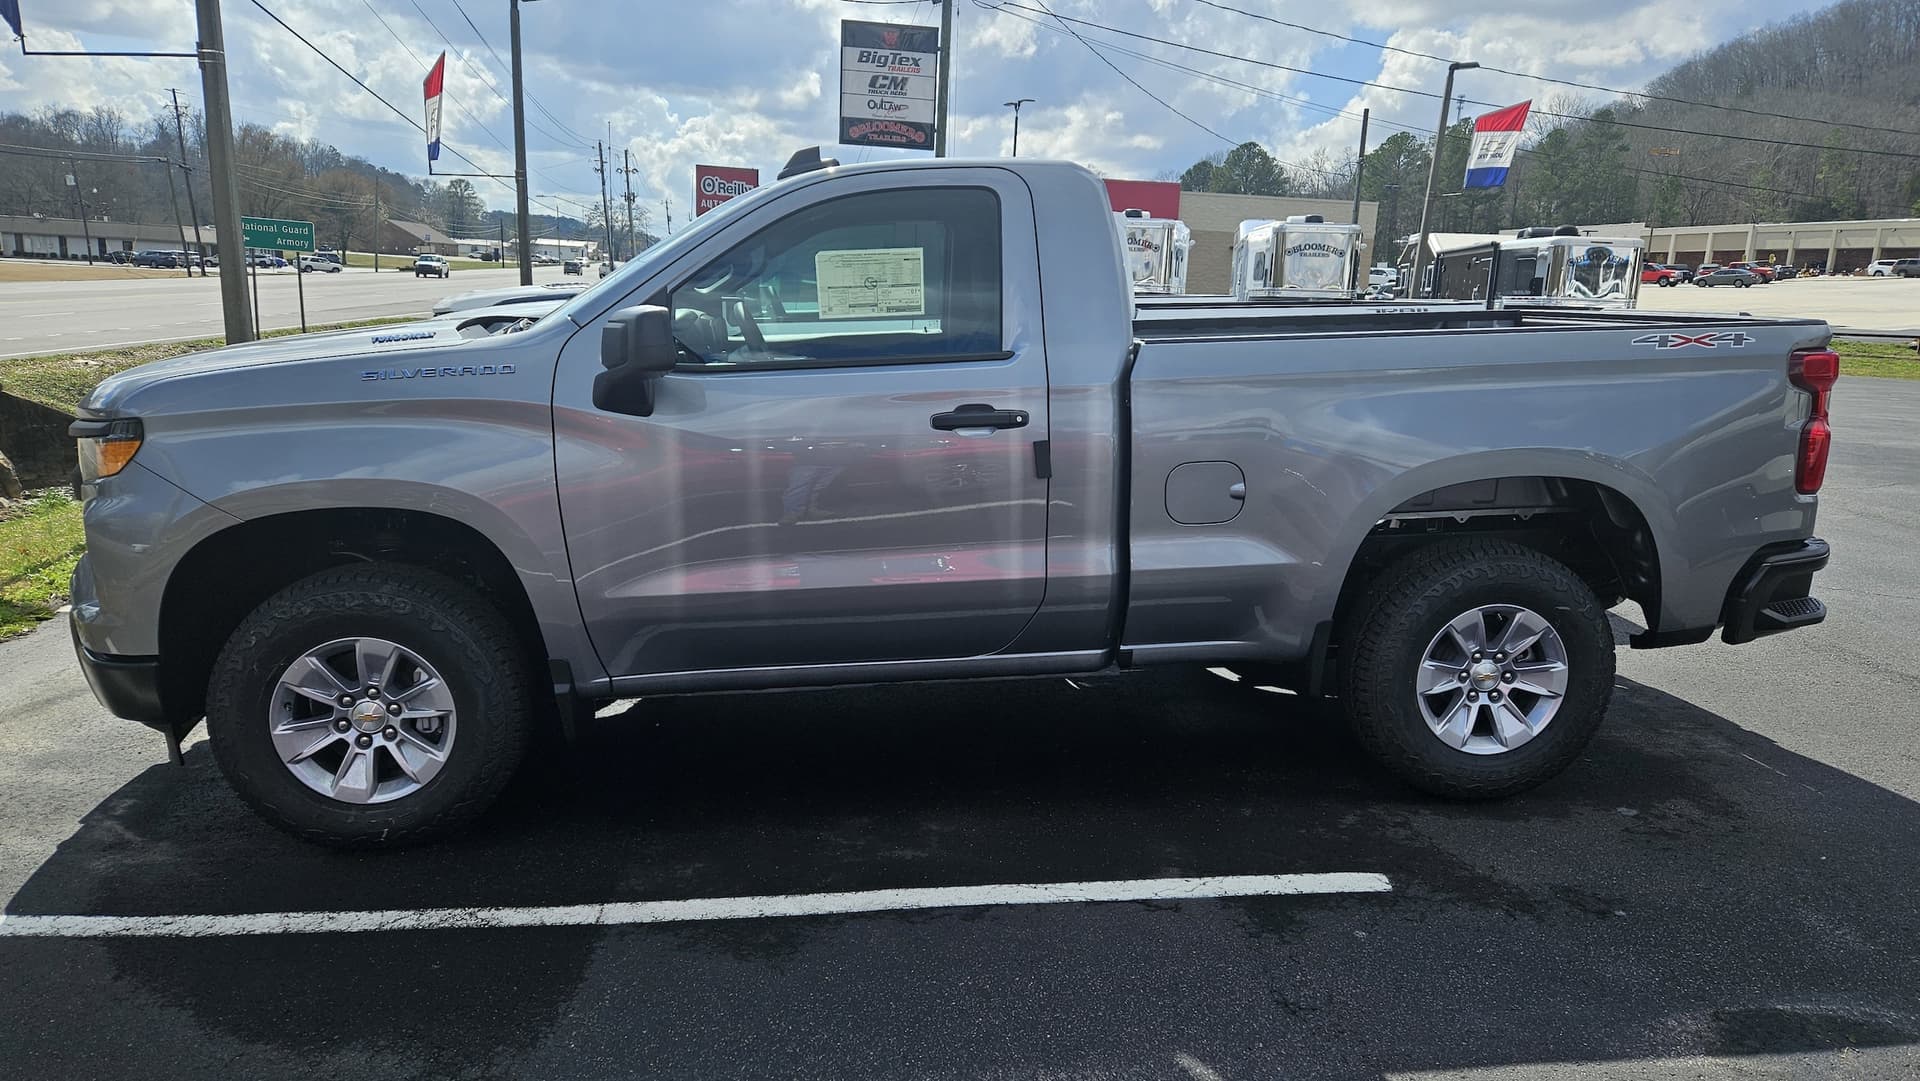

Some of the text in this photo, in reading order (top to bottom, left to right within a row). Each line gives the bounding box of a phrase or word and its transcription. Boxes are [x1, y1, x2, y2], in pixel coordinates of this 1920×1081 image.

[887, 64, 921, 73] TRAILERS
[868, 74, 910, 91] CM
[281, 225, 309, 235] Guard
[276, 238, 309, 249] Armory
[1292, 243, 1338, 255] BLOOMER
[361, 364, 517, 382] SILVERADO
